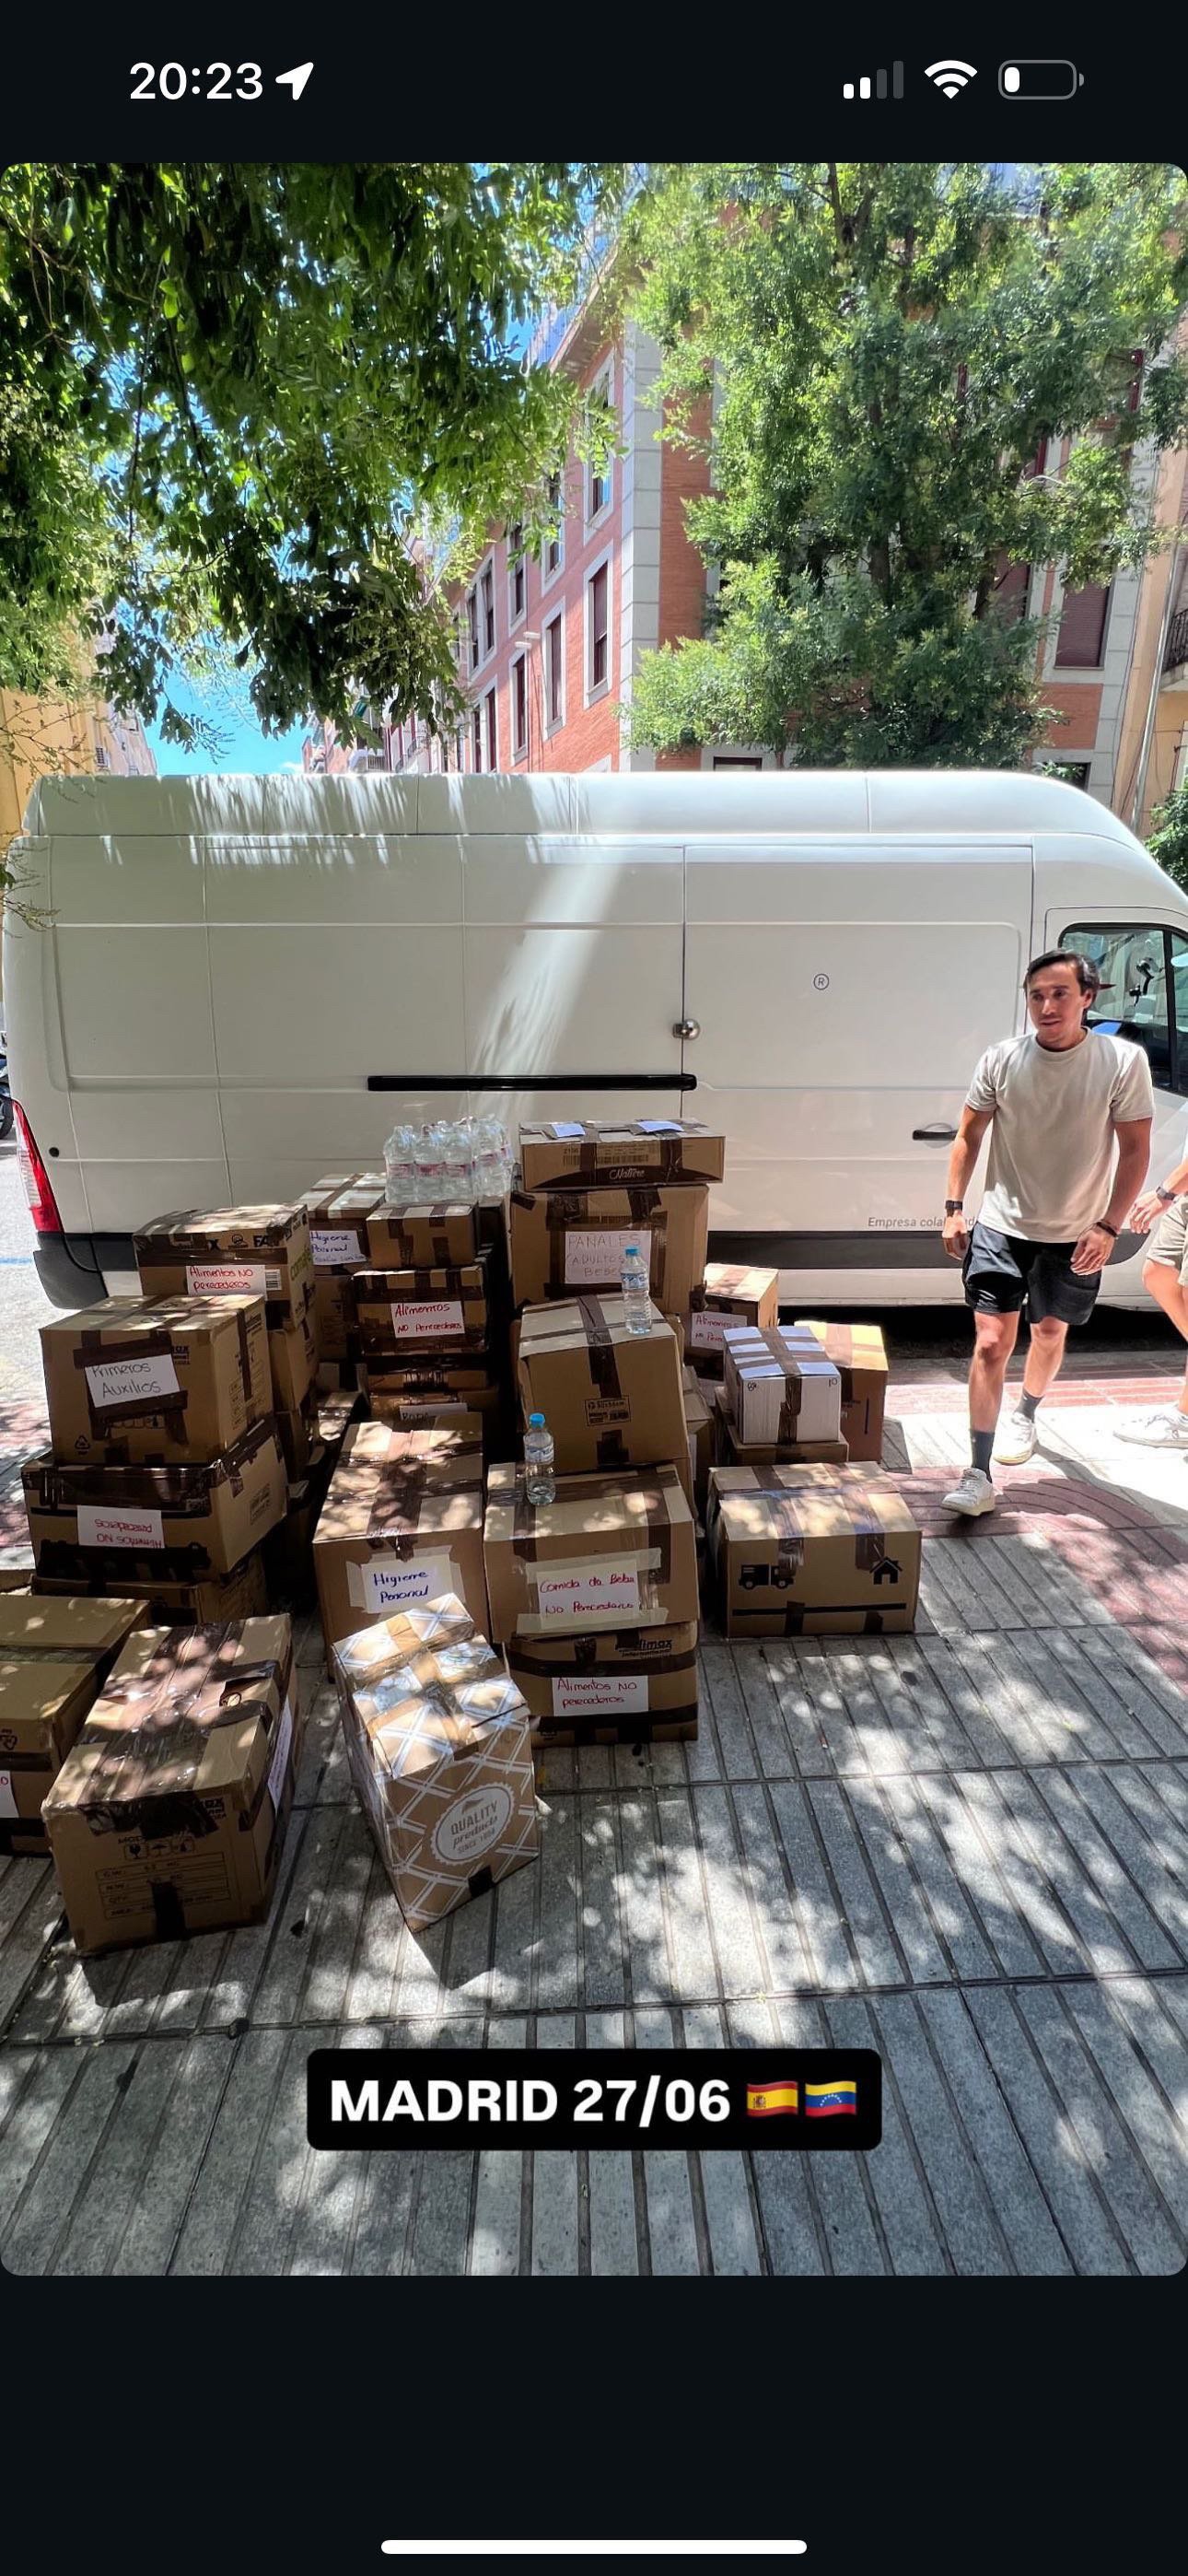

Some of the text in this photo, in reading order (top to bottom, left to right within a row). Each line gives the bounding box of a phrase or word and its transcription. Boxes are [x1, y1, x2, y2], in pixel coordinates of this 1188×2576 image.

[868, 1217, 917, 1229] Empresa
[190, 1265, 253, 1278] Alimentos NO
[395, 1303, 450, 1317] Alimentos
[91, 1363, 151, 1378] Primeros
[102, 1379, 161, 1399] Auxilios
[373, 1571, 429, 1588] Higiene
[540, 1579, 580, 1594] Comida
[557, 1676, 638, 1692] Alimentos NO
[450, 1799, 498, 1836] QUALITY
